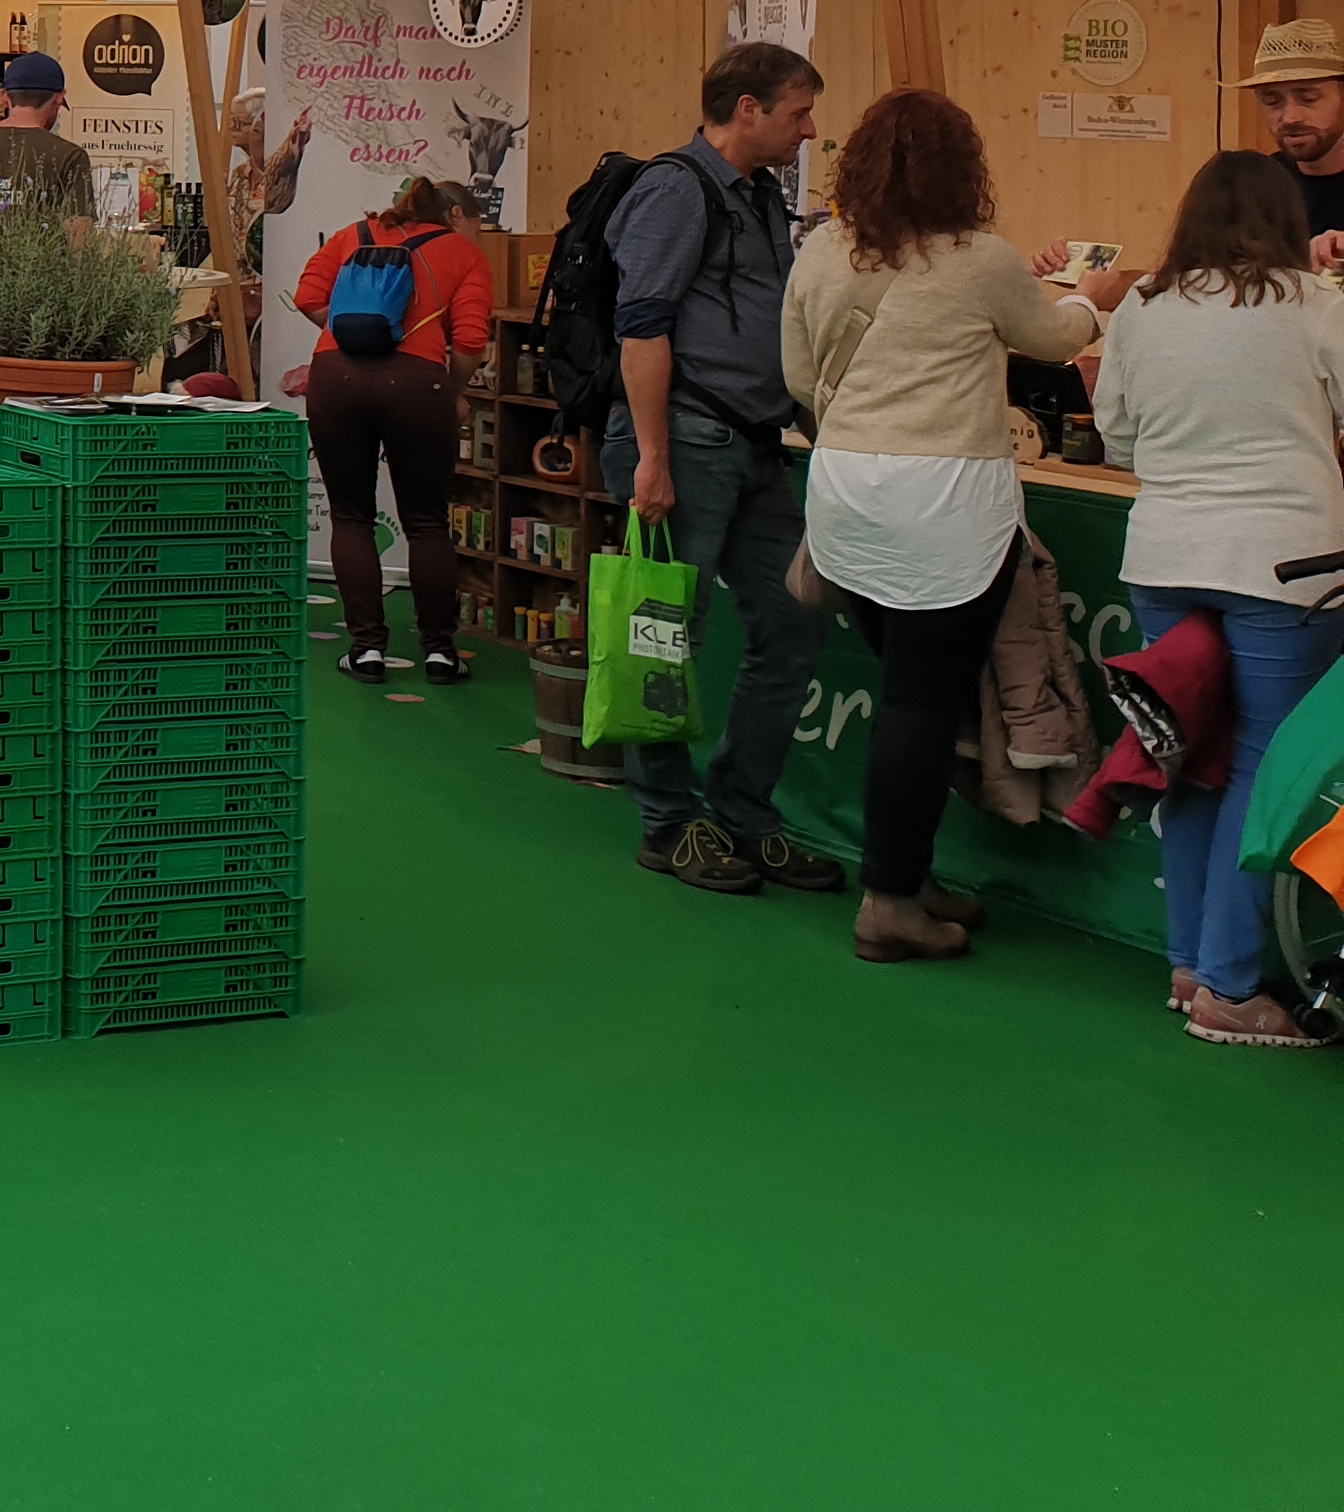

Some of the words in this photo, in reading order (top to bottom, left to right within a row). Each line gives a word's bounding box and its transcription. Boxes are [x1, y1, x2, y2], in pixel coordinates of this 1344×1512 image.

[324, 14, 389, 48] Darf
[1087, 19, 1129, 37] BIO
[94, 36, 154, 65] adrian
[1086, 39, 1128, 48] MUSTER
[1086, 49, 1128, 59] REGION
[296, 54, 409, 89] eigentlich
[417, 59, 476, 83] noch
[343, 94, 426, 122] Fleisch
[82, 118, 164, 135] FEINSTES
[81, 142, 99, 150] aus
[101, 140, 164, 155] Fruchtessig
[349, 139, 428, 164] essen?
